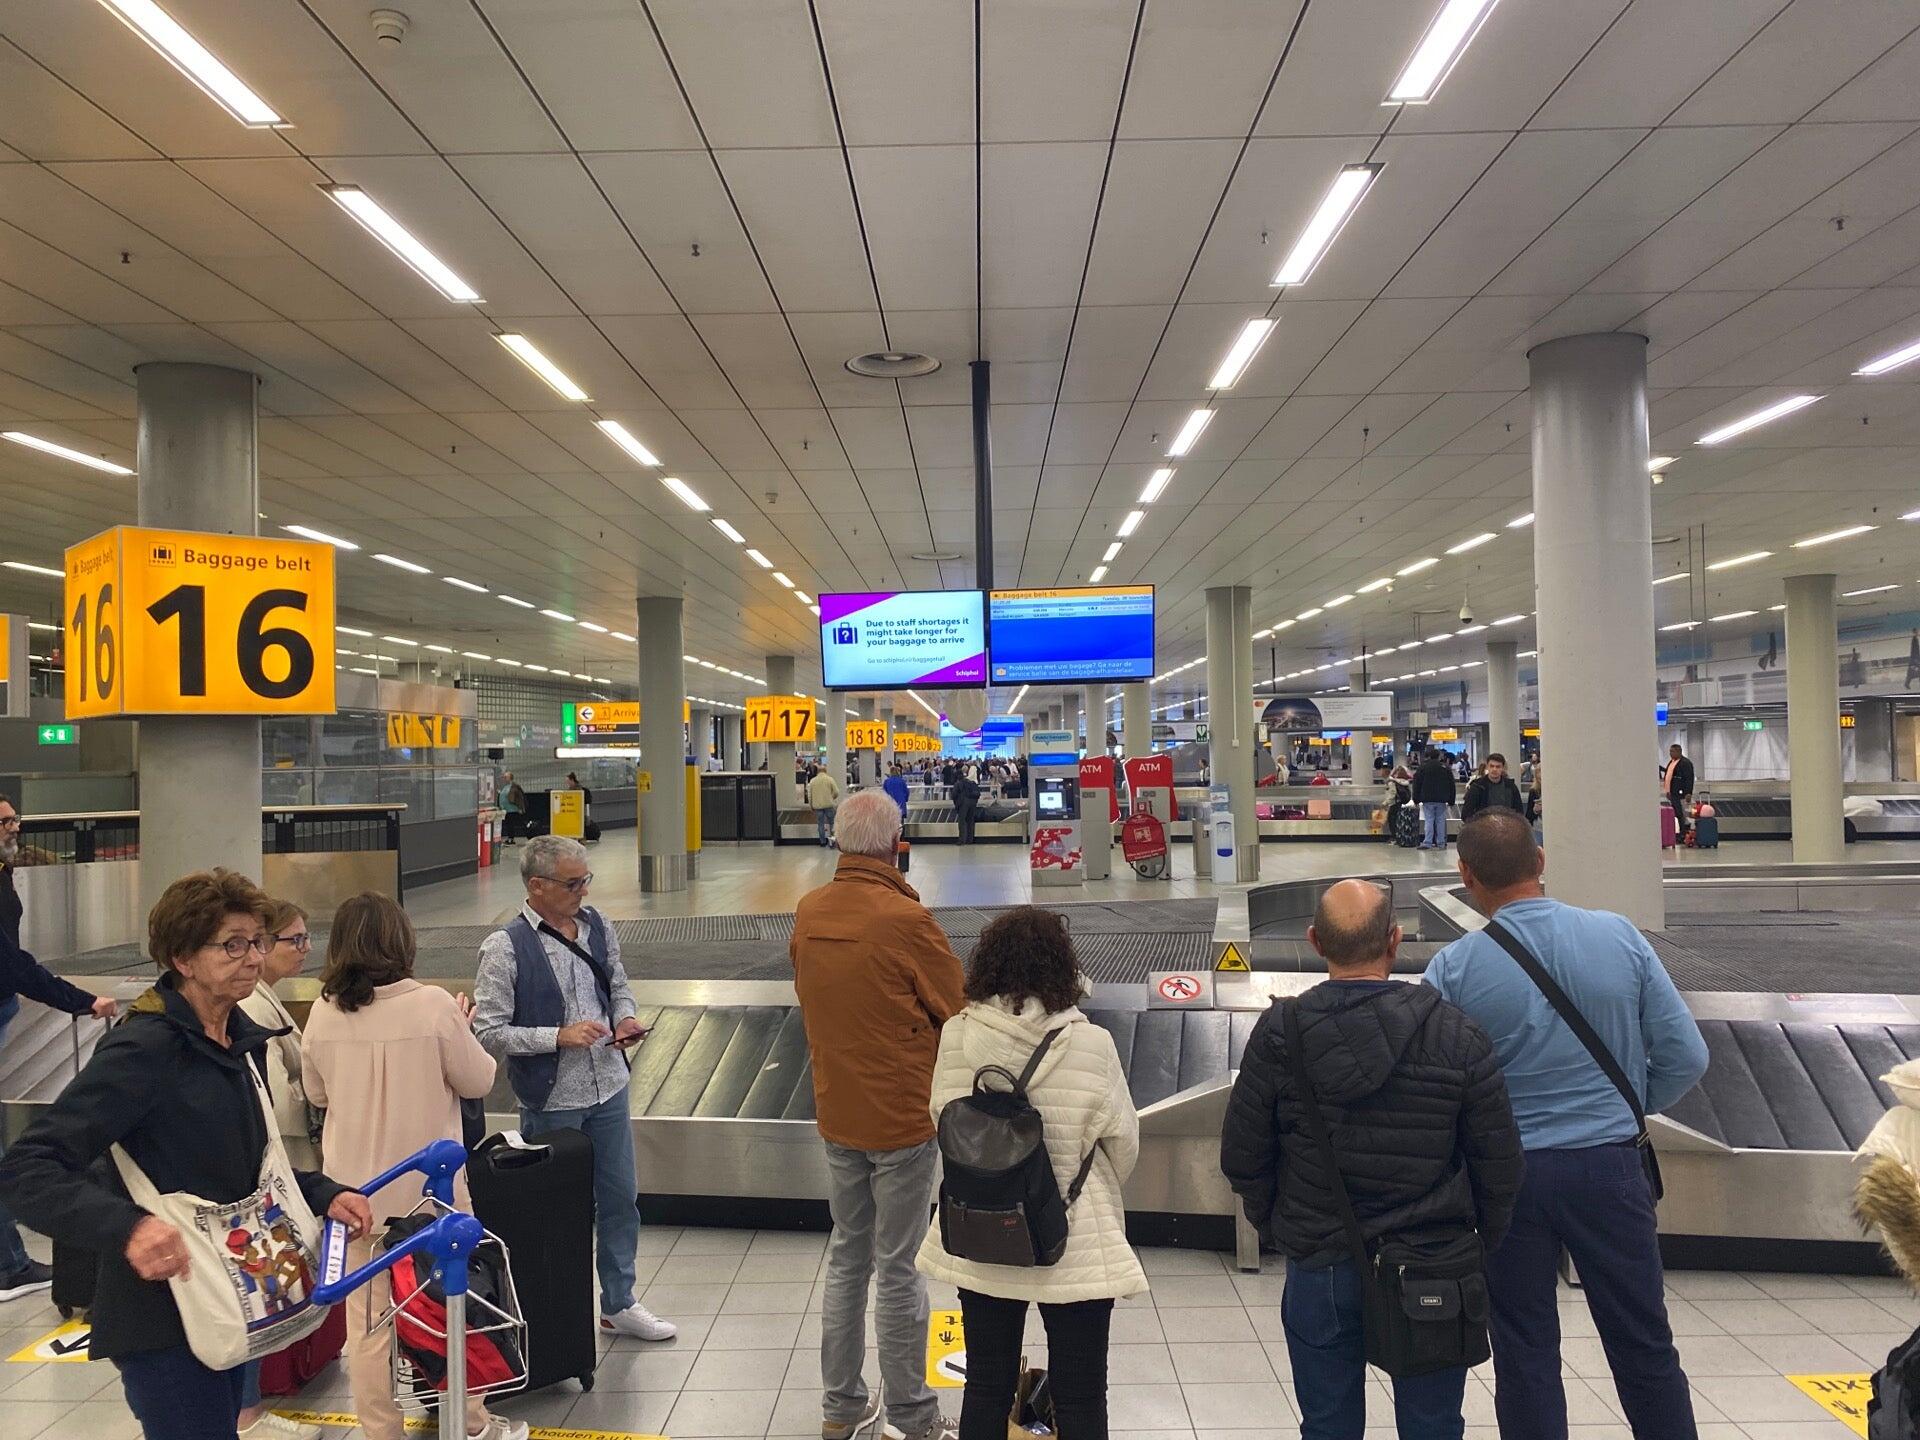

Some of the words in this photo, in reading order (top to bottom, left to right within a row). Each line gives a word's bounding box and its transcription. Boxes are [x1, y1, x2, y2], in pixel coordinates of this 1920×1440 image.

[184, 549, 268, 573] Baggage
[276, 555, 312, 572] belt
[866, 620, 883, 628] Due
[896, 618, 916, 627] staff
[918, 618, 961, 628] shortages
[962, 617, 969, 625] it
[866, 628, 893, 638] might
[894, 628, 913, 636] take
[915, 628, 943, 637] longer
[945, 627, 958, 635] for
[72, 582, 115, 702] 16
[146, 584, 315, 699] 16
[866, 639, 886, 648] your
[888, 637, 926, 647] baggage
[939, 636, 965, 645] arrive
[955, 669, 979, 677] Schiphol
[750, 710, 771, 738] 17
[779, 709, 811, 737] 17
[849, 729, 864, 745] 18
[867, 729, 885, 745] 18
[901, 738, 914, 750] 19
[916, 740, 926, 750] 20
[1080, 764, 1102, 773] ATM
[1138, 763, 1160, 772] ATM
[290, 1411, 332, 1423] Please
[539, 1427, 592, 1440] houden
